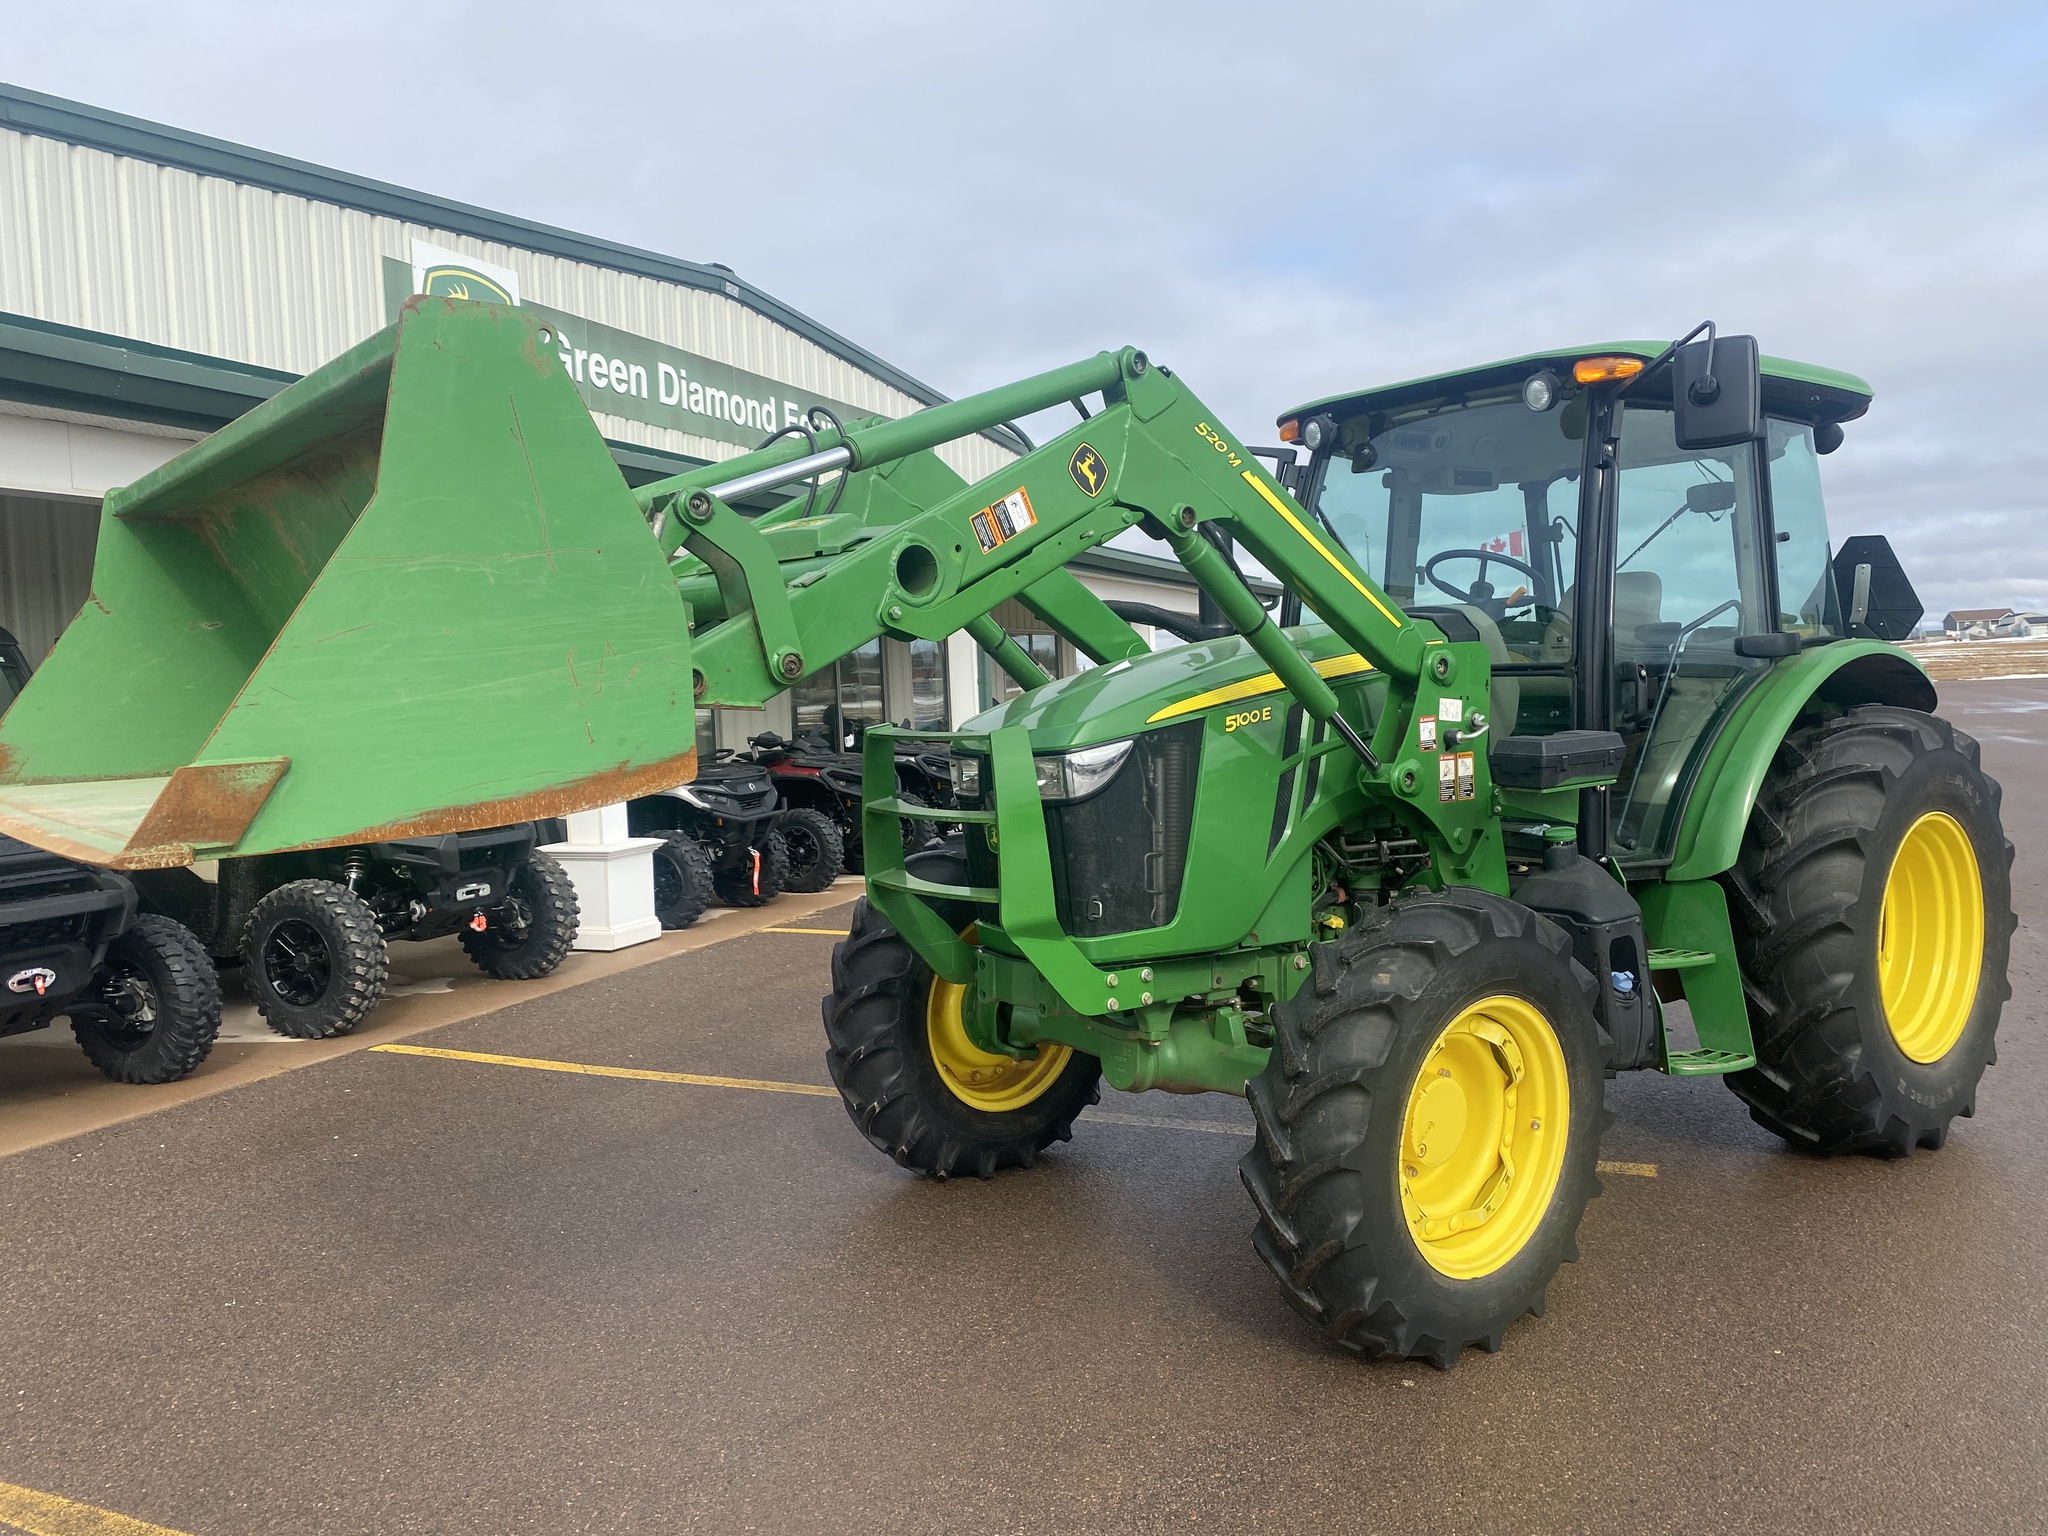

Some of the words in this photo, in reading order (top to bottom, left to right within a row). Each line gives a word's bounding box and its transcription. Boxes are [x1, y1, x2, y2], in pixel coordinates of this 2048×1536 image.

[658, 362, 776, 433] Diamond
[1193, 421, 1228, 453] 520
[1227, 451, 1243, 468] M
[1225, 709, 1261, 733] 5100
[1262, 706, 1272, 721] E
